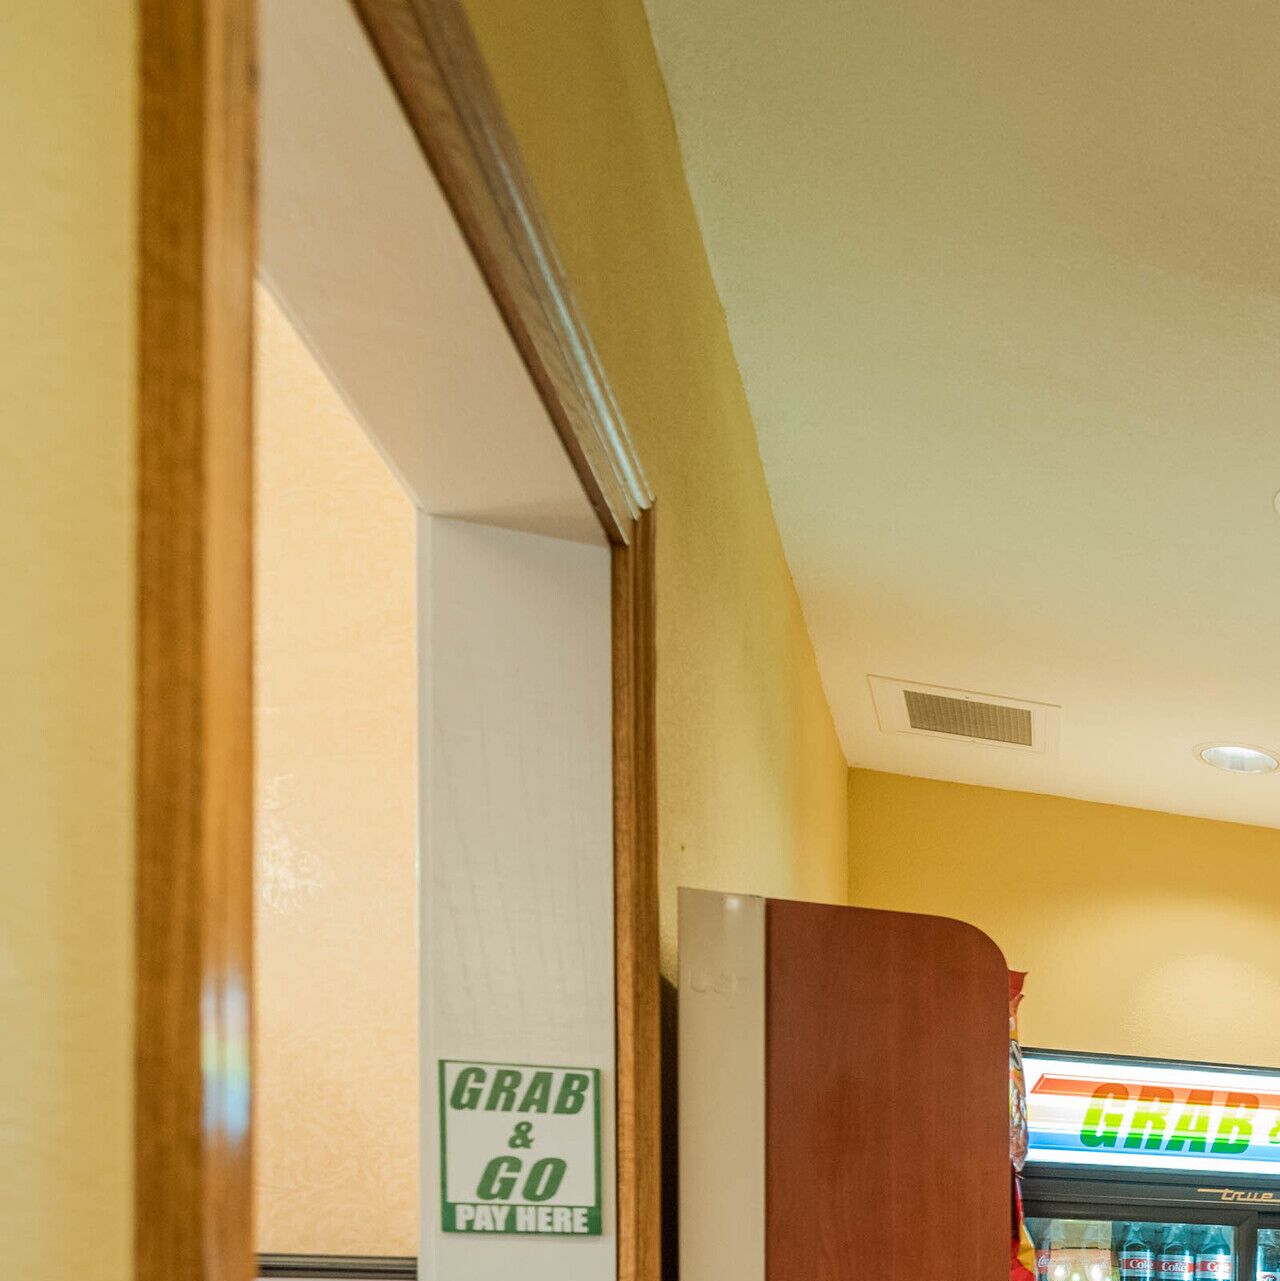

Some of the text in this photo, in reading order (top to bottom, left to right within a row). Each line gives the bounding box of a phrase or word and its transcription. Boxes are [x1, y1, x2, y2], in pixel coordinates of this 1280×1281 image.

[450, 1066, 591, 1116] GRAB
[1079, 1082, 1260, 1155] GRAB
[507, 1120, 536, 1150] &
[476, 1155, 568, 1203] GO
[454, 1203, 590, 1234] PAY HERE
[1161, 1261, 1187, 1273] Coke
[1206, 1261, 1231, 1273] Coe
